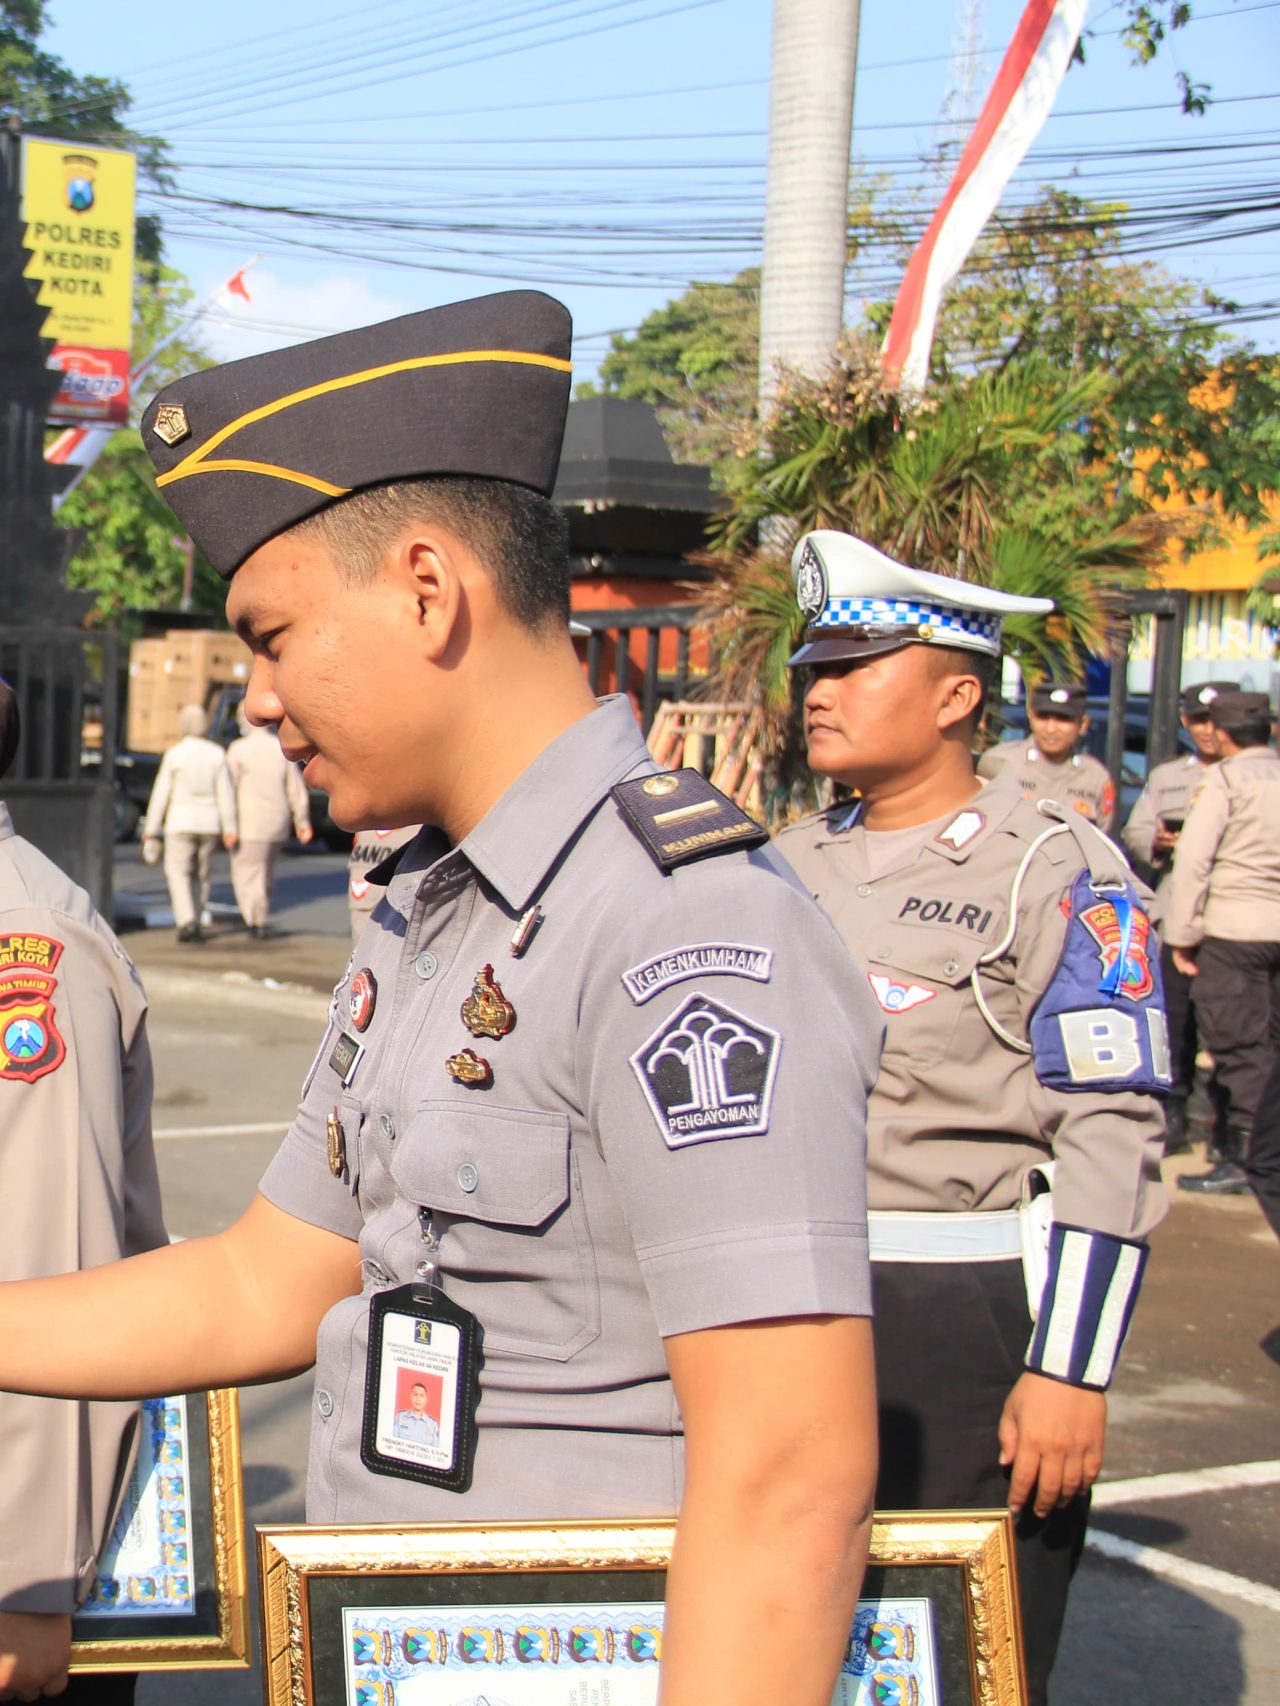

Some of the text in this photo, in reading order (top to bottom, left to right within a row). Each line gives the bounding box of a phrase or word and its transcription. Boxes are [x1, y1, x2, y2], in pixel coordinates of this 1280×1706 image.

[34, 222, 121, 250] POLRES
[43, 250, 112, 273] KEDIRI
[50, 276, 103, 297] KOTA
[662, 822, 754, 854] KUMHAM
[898, 897, 993, 934] POLRI
[17, 951, 50, 968] KOTA
[634, 949, 763, 993] KEMENKUMHAM
[14, 979, 48, 990] TIMUR
[668, 1104, 758, 1132] PENGAYOMAN
